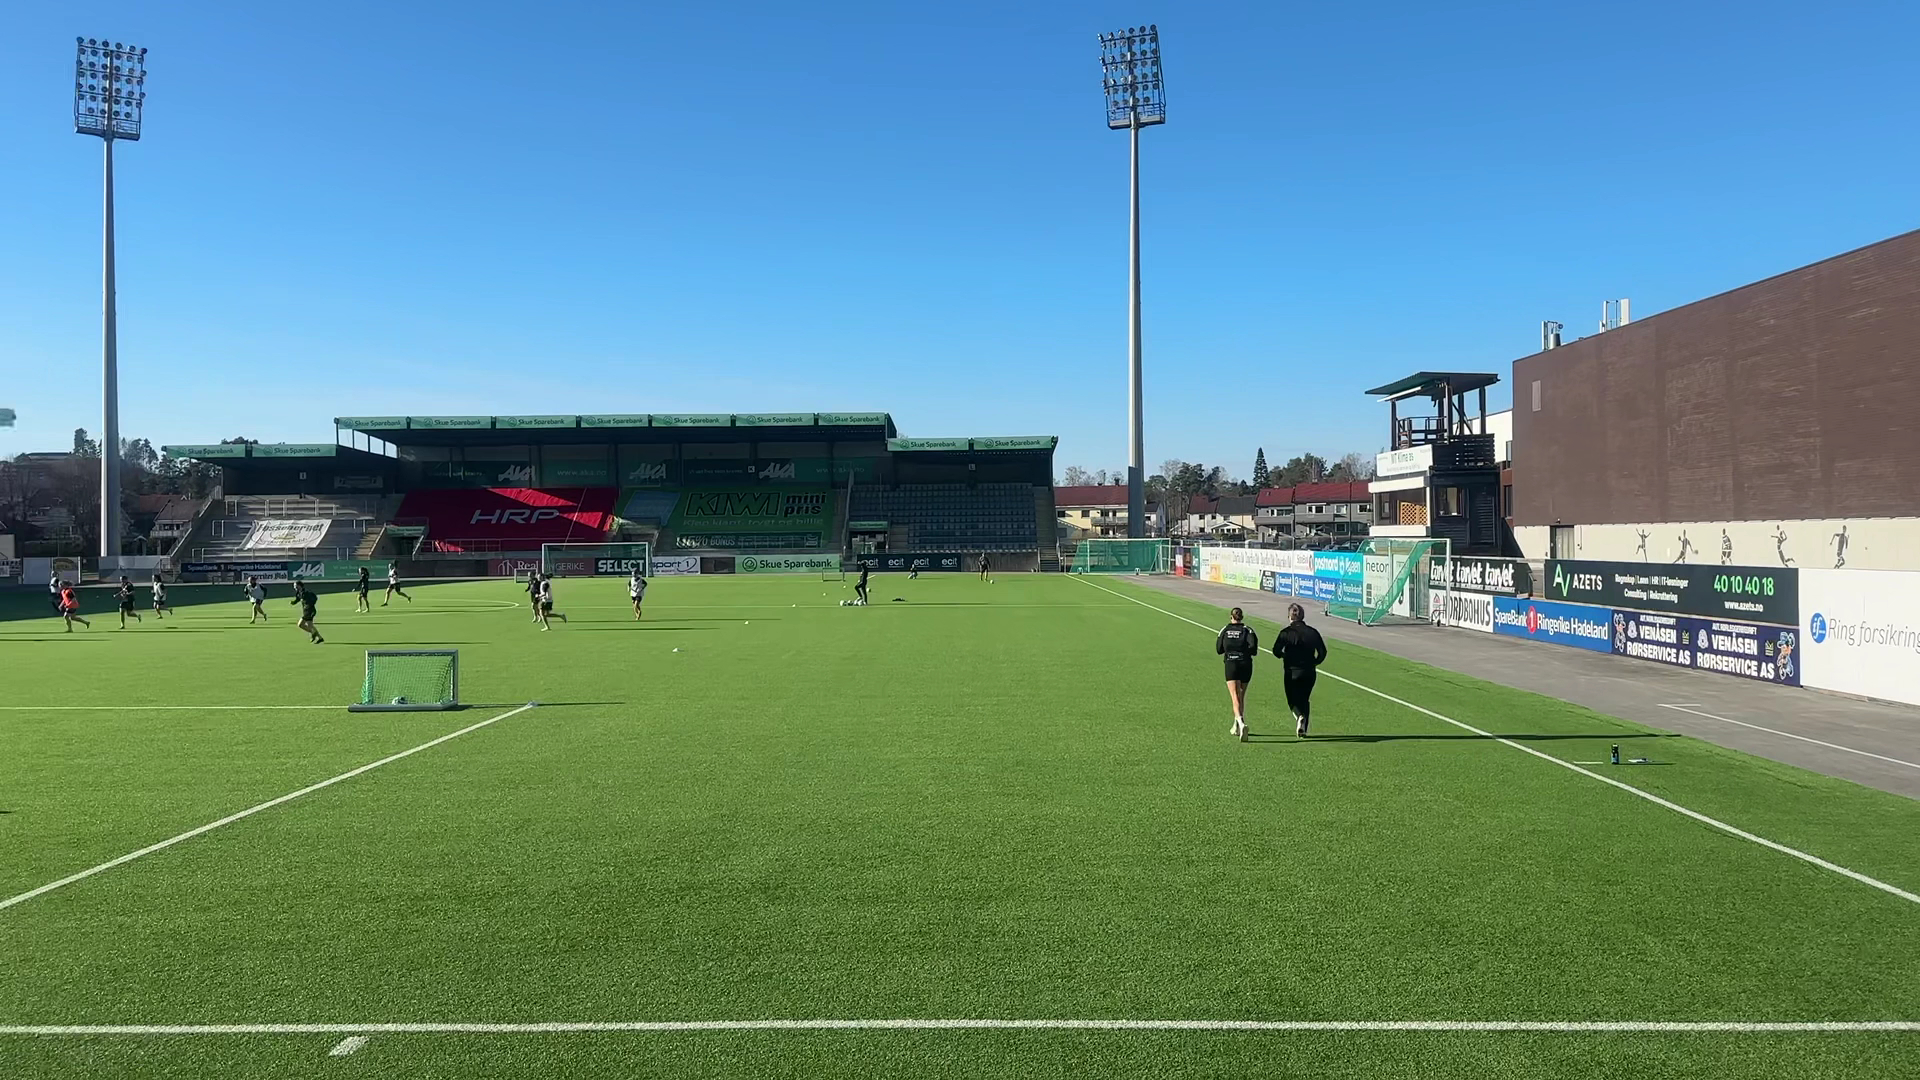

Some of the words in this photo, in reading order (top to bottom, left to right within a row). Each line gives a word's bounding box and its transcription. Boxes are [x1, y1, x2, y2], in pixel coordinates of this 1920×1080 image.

[450, 419, 481, 427] Sparebank
[772, 416, 803, 424] Sparebank
[849, 416, 880, 424] Sparebank
[926, 441, 957, 449] Sparebank
[1010, 439, 1041, 447] Sparebank
[289, 447, 321, 455] Sparebank
[785, 492, 826, 504] mini
[684, 492, 783, 517] KIWI
[470, 509, 560, 524] HRP
[783, 505, 822, 517] pris
[517, 560, 539, 570] Real
[598, 560, 645, 572] SELECT
[760, 559, 782, 569] Skue
[784, 558, 832, 570] Sparebank
[888, 558, 904, 566] ecit
[914, 557, 930, 566] ecit
[941, 557, 957, 566] ecit
[293, 563, 325, 577] AKA
[1572, 575, 1603, 591] AZETS
[1651, 576, 1659, 585] HR
[1714, 574, 1729, 593] 40
[1730, 575, 1743, 594] 10
[1745, 576, 1760, 595] 40
[1762, 577, 1774, 596] 18
[1724, 601, 1764, 612] www.azets.no
[1494, 607, 1527, 627] SpareBank
[1537, 613, 1570, 635] Ringerike
[1571, 618, 1608, 640] Hadeland
[1639, 623, 1677, 644] VENÅSEN
[1828, 618, 1857, 646] Ring
[1857, 621, 1920, 655] forsikring
[1712, 632, 1758, 655] VENÅSEN
[1626, 641, 1677, 662] RØRSERVICE
[1678, 649, 1691, 665] AS
[1697, 652, 1758, 677] RØRSERVICE
[1759, 662, 1775, 679] AS
